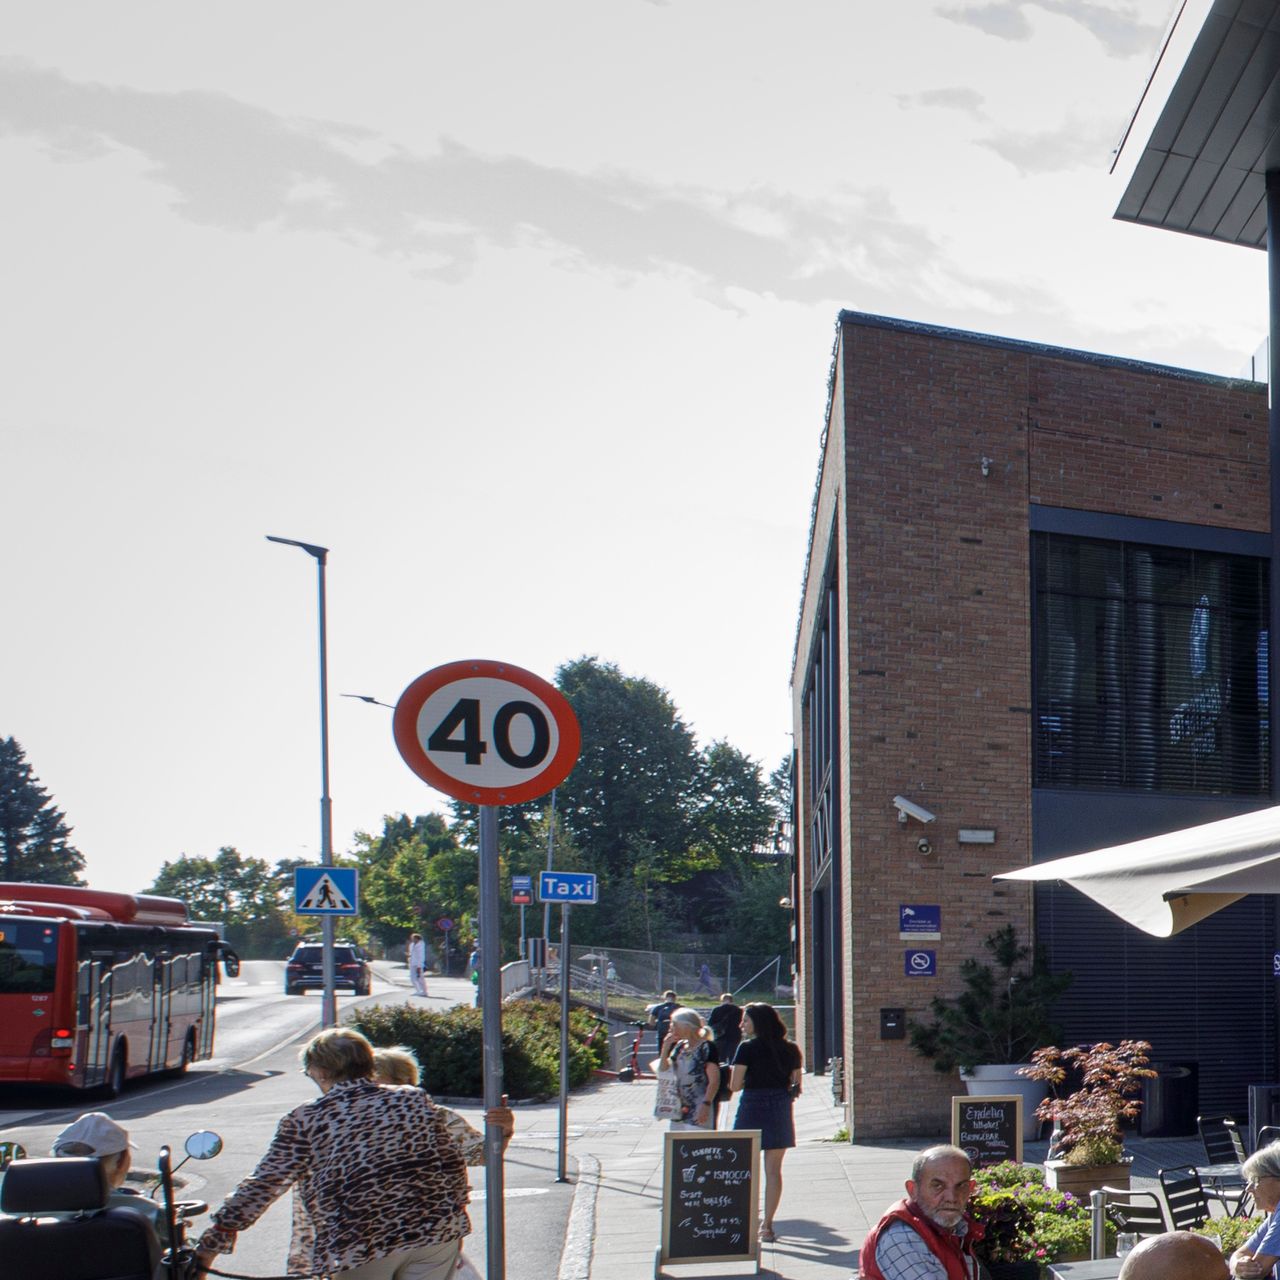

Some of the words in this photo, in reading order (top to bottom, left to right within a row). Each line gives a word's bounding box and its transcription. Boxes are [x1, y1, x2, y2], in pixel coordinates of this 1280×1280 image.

[428, 698, 550, 769] 40
[544, 878, 592, 896] Taxi
[713, 1170, 751, 1180] ISMOCCA
